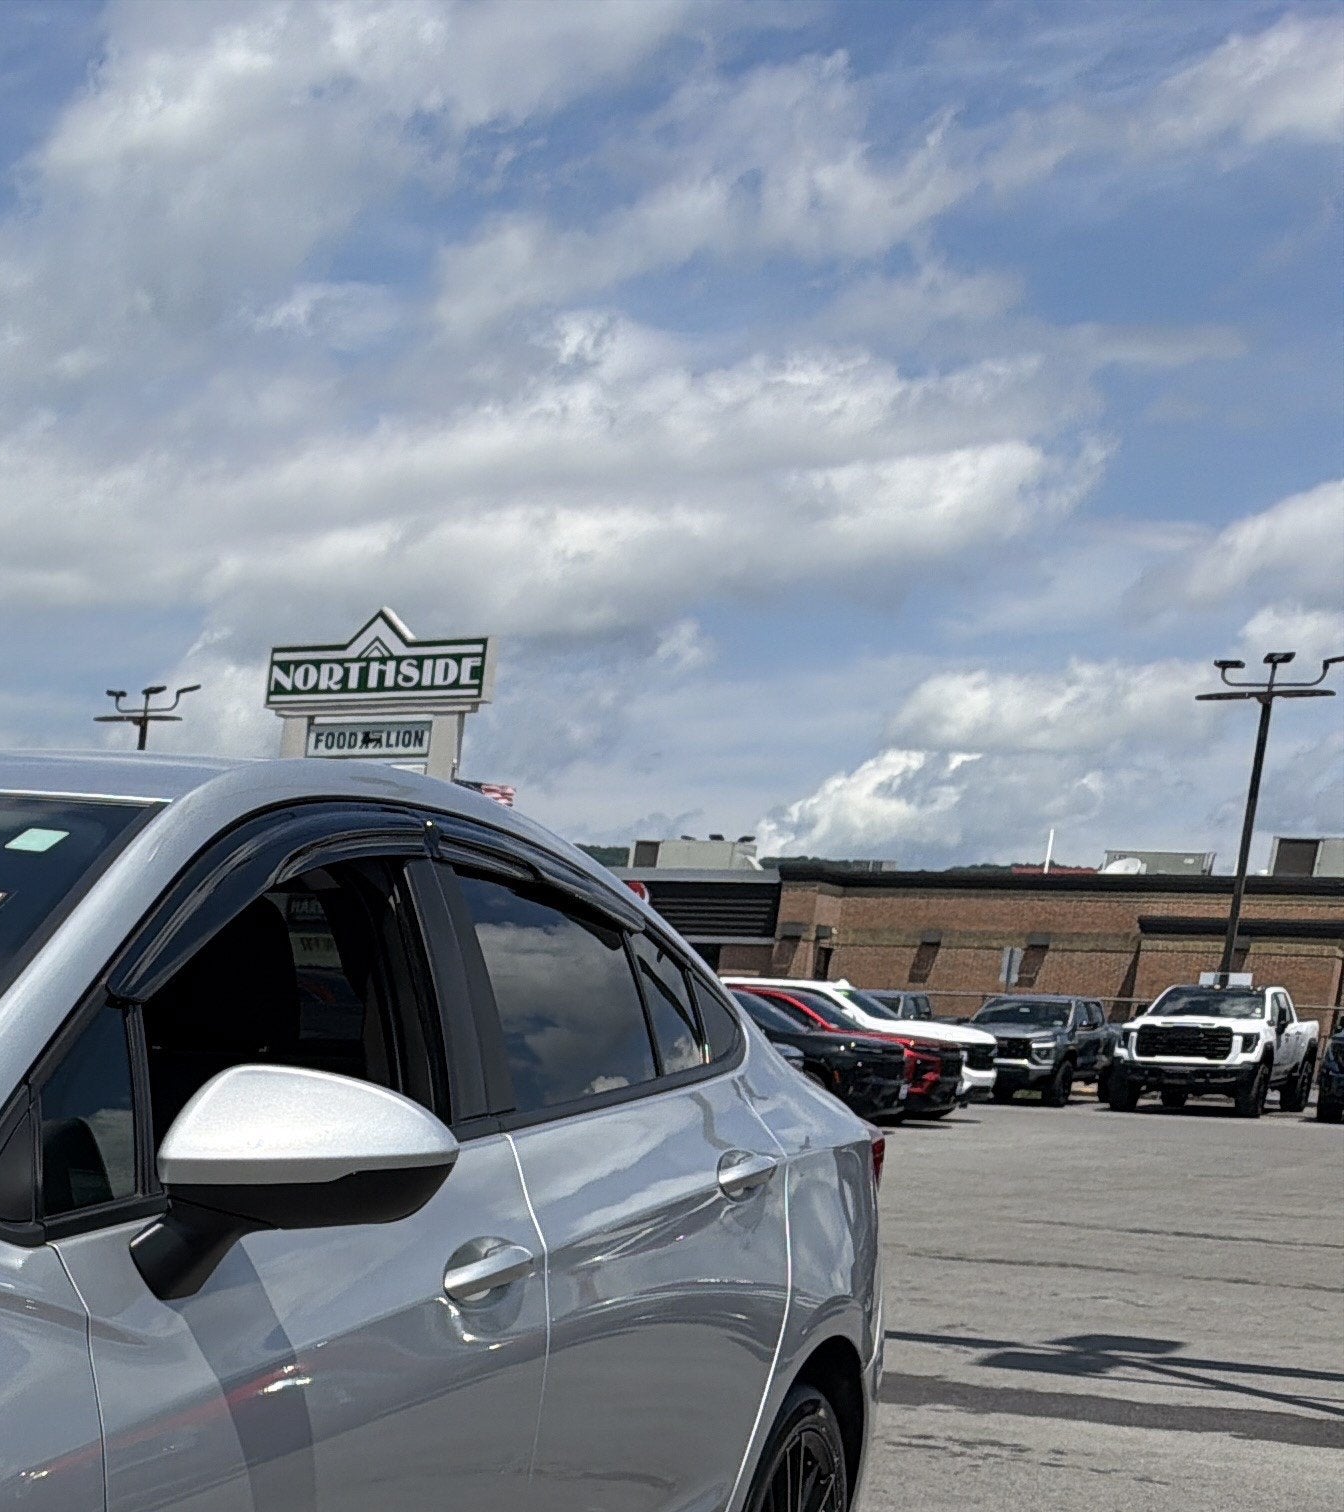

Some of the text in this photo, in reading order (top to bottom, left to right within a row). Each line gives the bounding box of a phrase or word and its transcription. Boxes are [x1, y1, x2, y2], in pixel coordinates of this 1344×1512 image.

[271, 657, 481, 691] NORTHSIDE
[314, 730, 424, 750] FOOD LION
